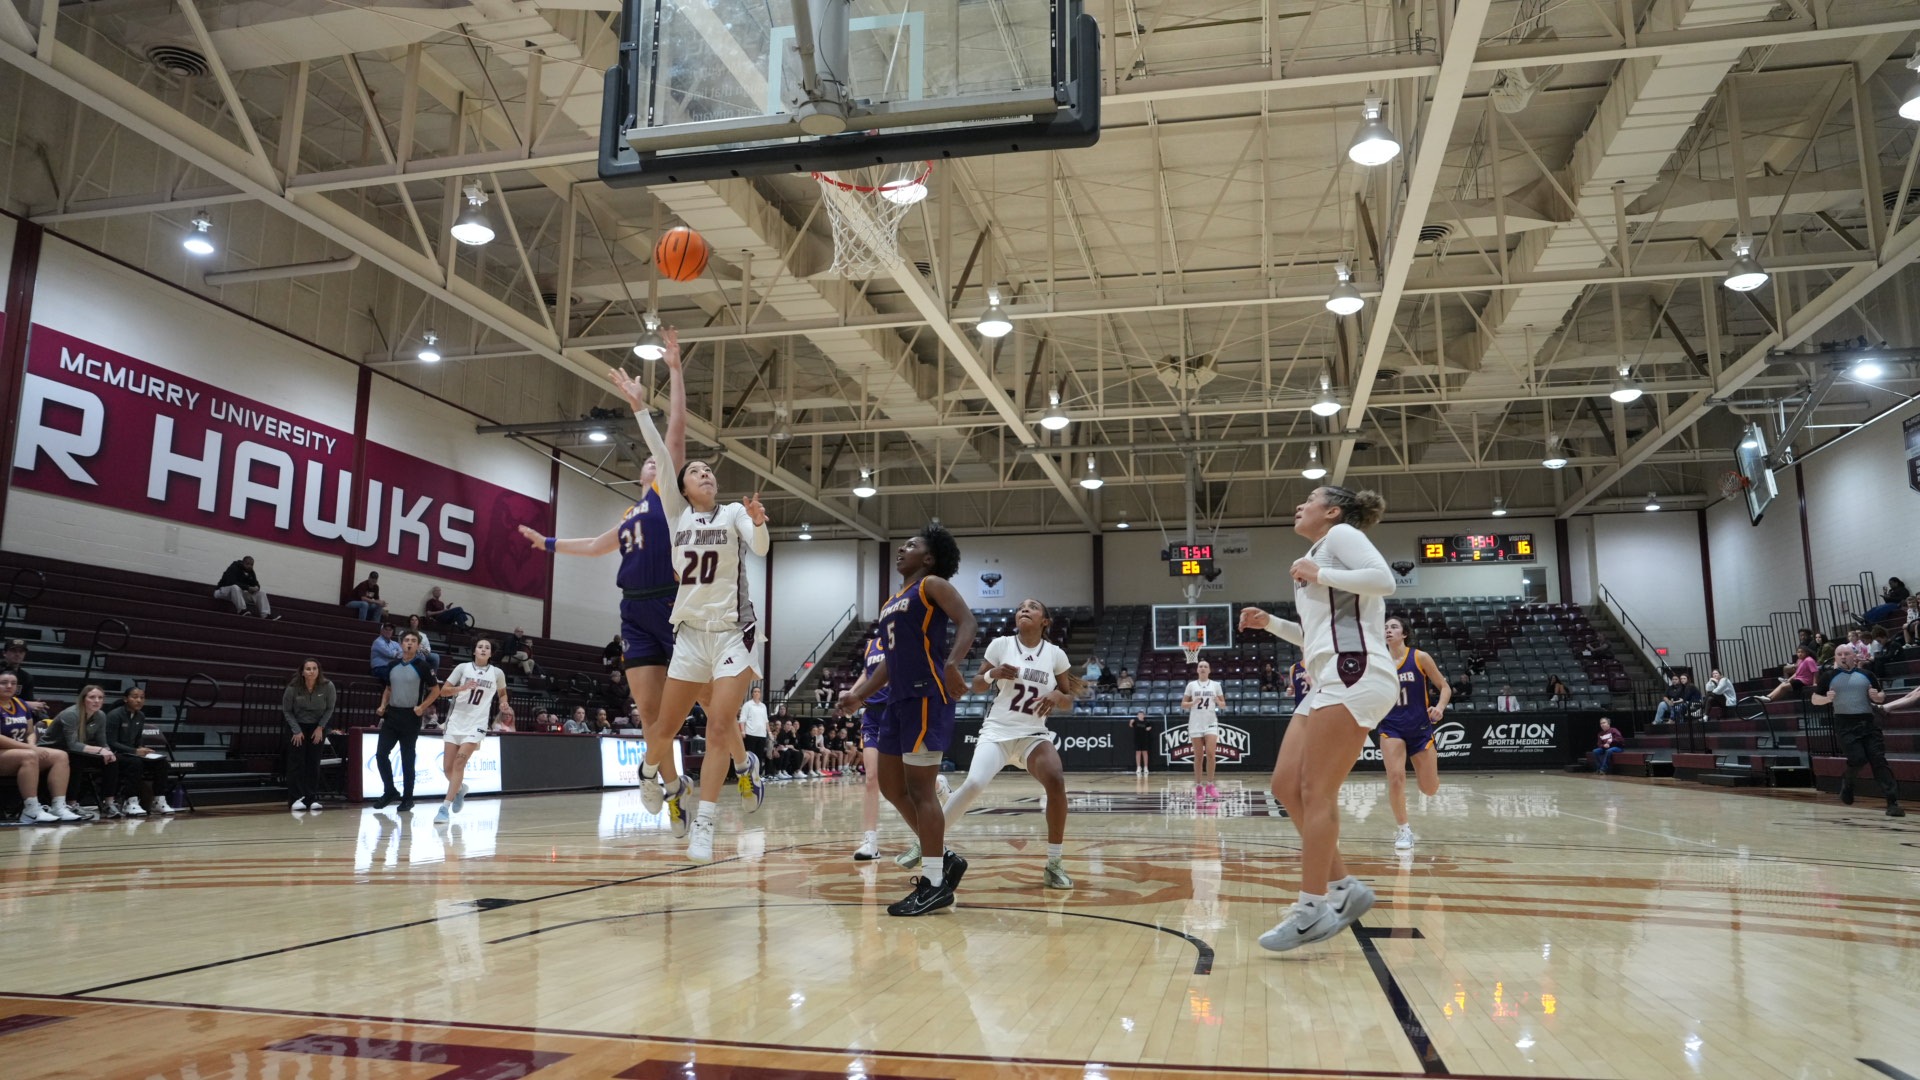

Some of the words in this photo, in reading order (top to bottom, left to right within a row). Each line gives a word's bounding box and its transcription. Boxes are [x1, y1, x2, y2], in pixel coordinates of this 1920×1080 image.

[59, 346, 200, 411] McMURRY
[210, 398, 337, 455] UNIVERSITY
[146, 412, 475, 571] HAWKS
[1467, 535, 1495, 549] 7:54
[1508, 534, 1531, 542] VISITOR
[1180, 545, 1211, 560] 7:54
[1426, 544, 1444, 558] 23
[1498, 549, 1504, 558] 3
[1517, 541, 1531, 555] 16
[1473, 550, 1481, 561] 2
[681, 550, 718, 585] 20
[1182, 560, 1200, 575] 26
[886, 621, 896, 650] 5
[467, 688, 485, 706] 10
[1009, 683, 1039, 715] 22
[1197, 697, 1210, 710] 24
[1482, 723, 1556, 740] ACTION
[964, 735, 979, 743] Fir
[1165, 727, 1247, 751] McRRY
[1515, 738, 1550, 746] MEDICINE
[479, 758, 497, 771] Joint
